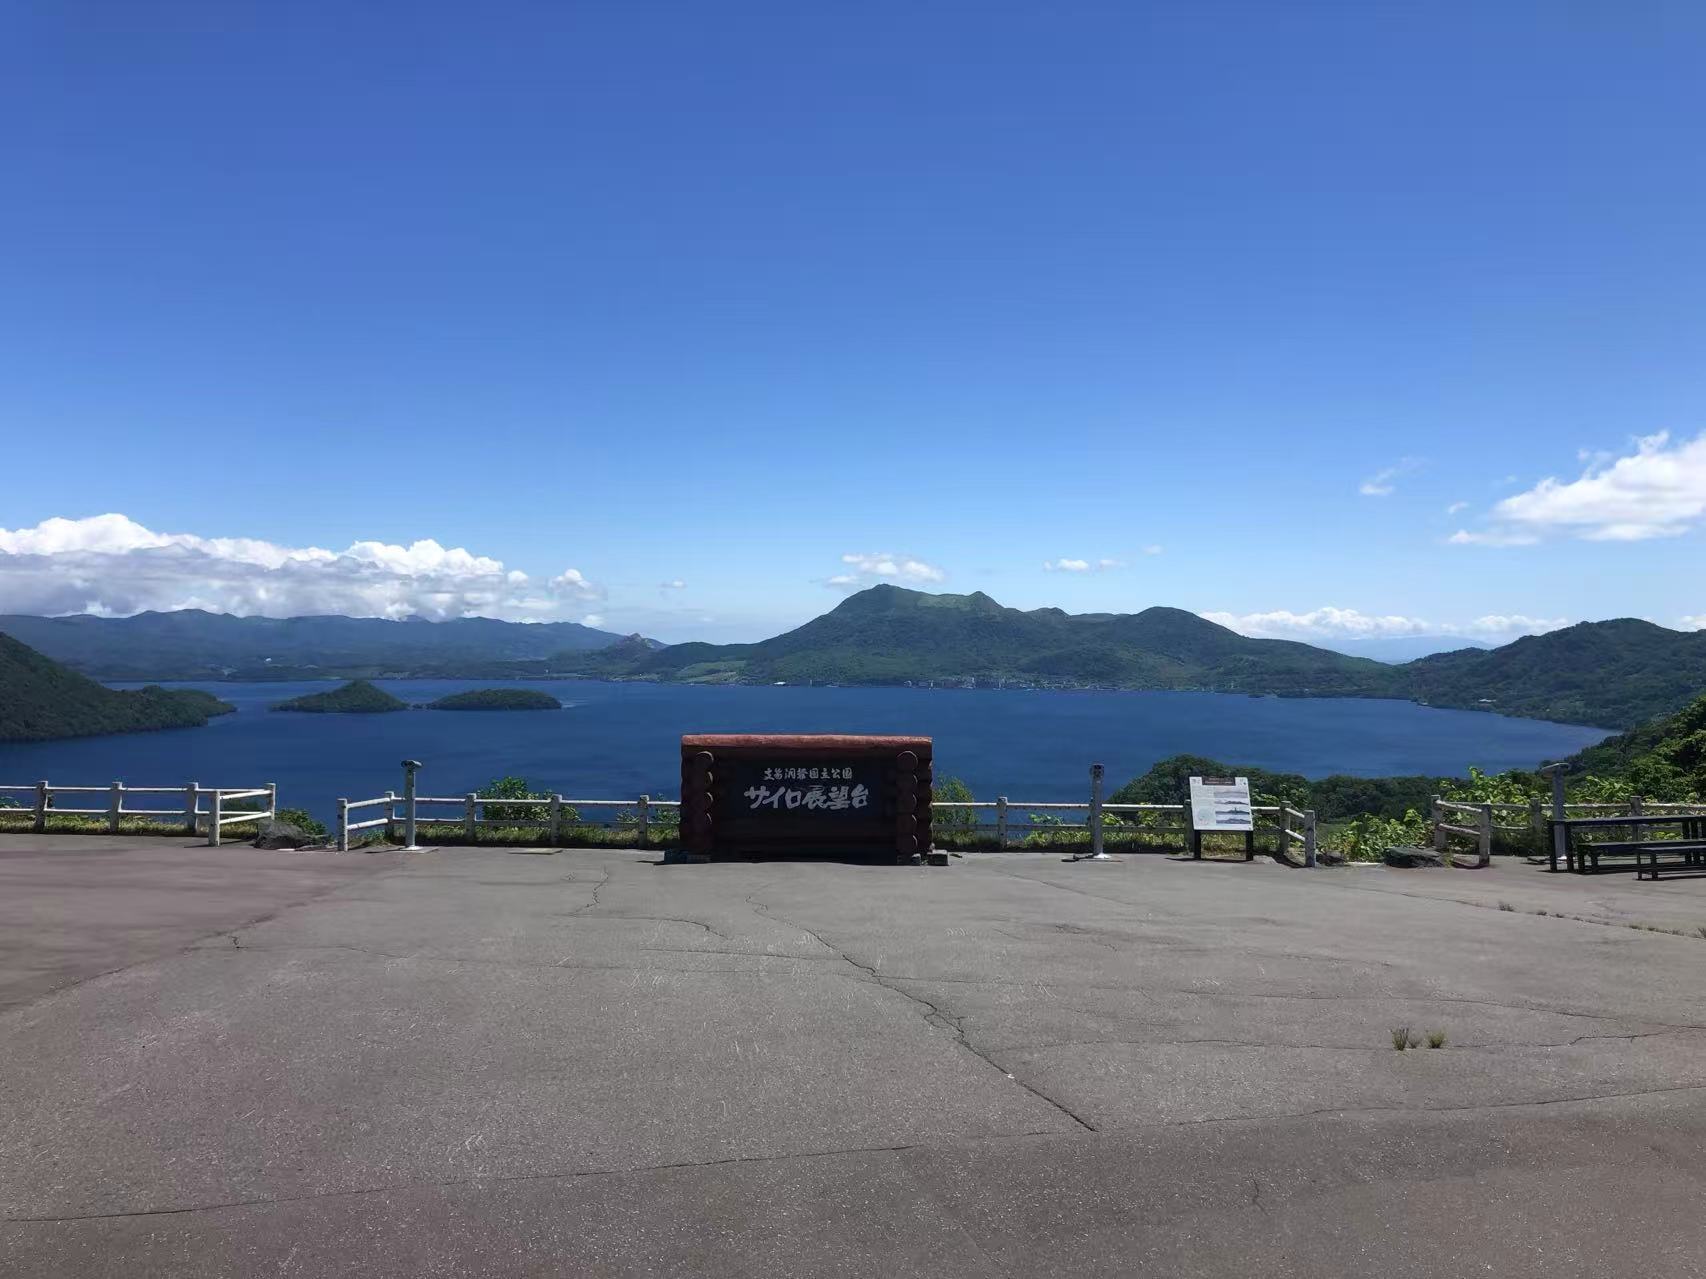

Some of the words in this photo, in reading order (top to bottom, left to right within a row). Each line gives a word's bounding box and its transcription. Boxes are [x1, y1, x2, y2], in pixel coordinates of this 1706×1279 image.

[743, 783, 869, 810] サイロ展望台
